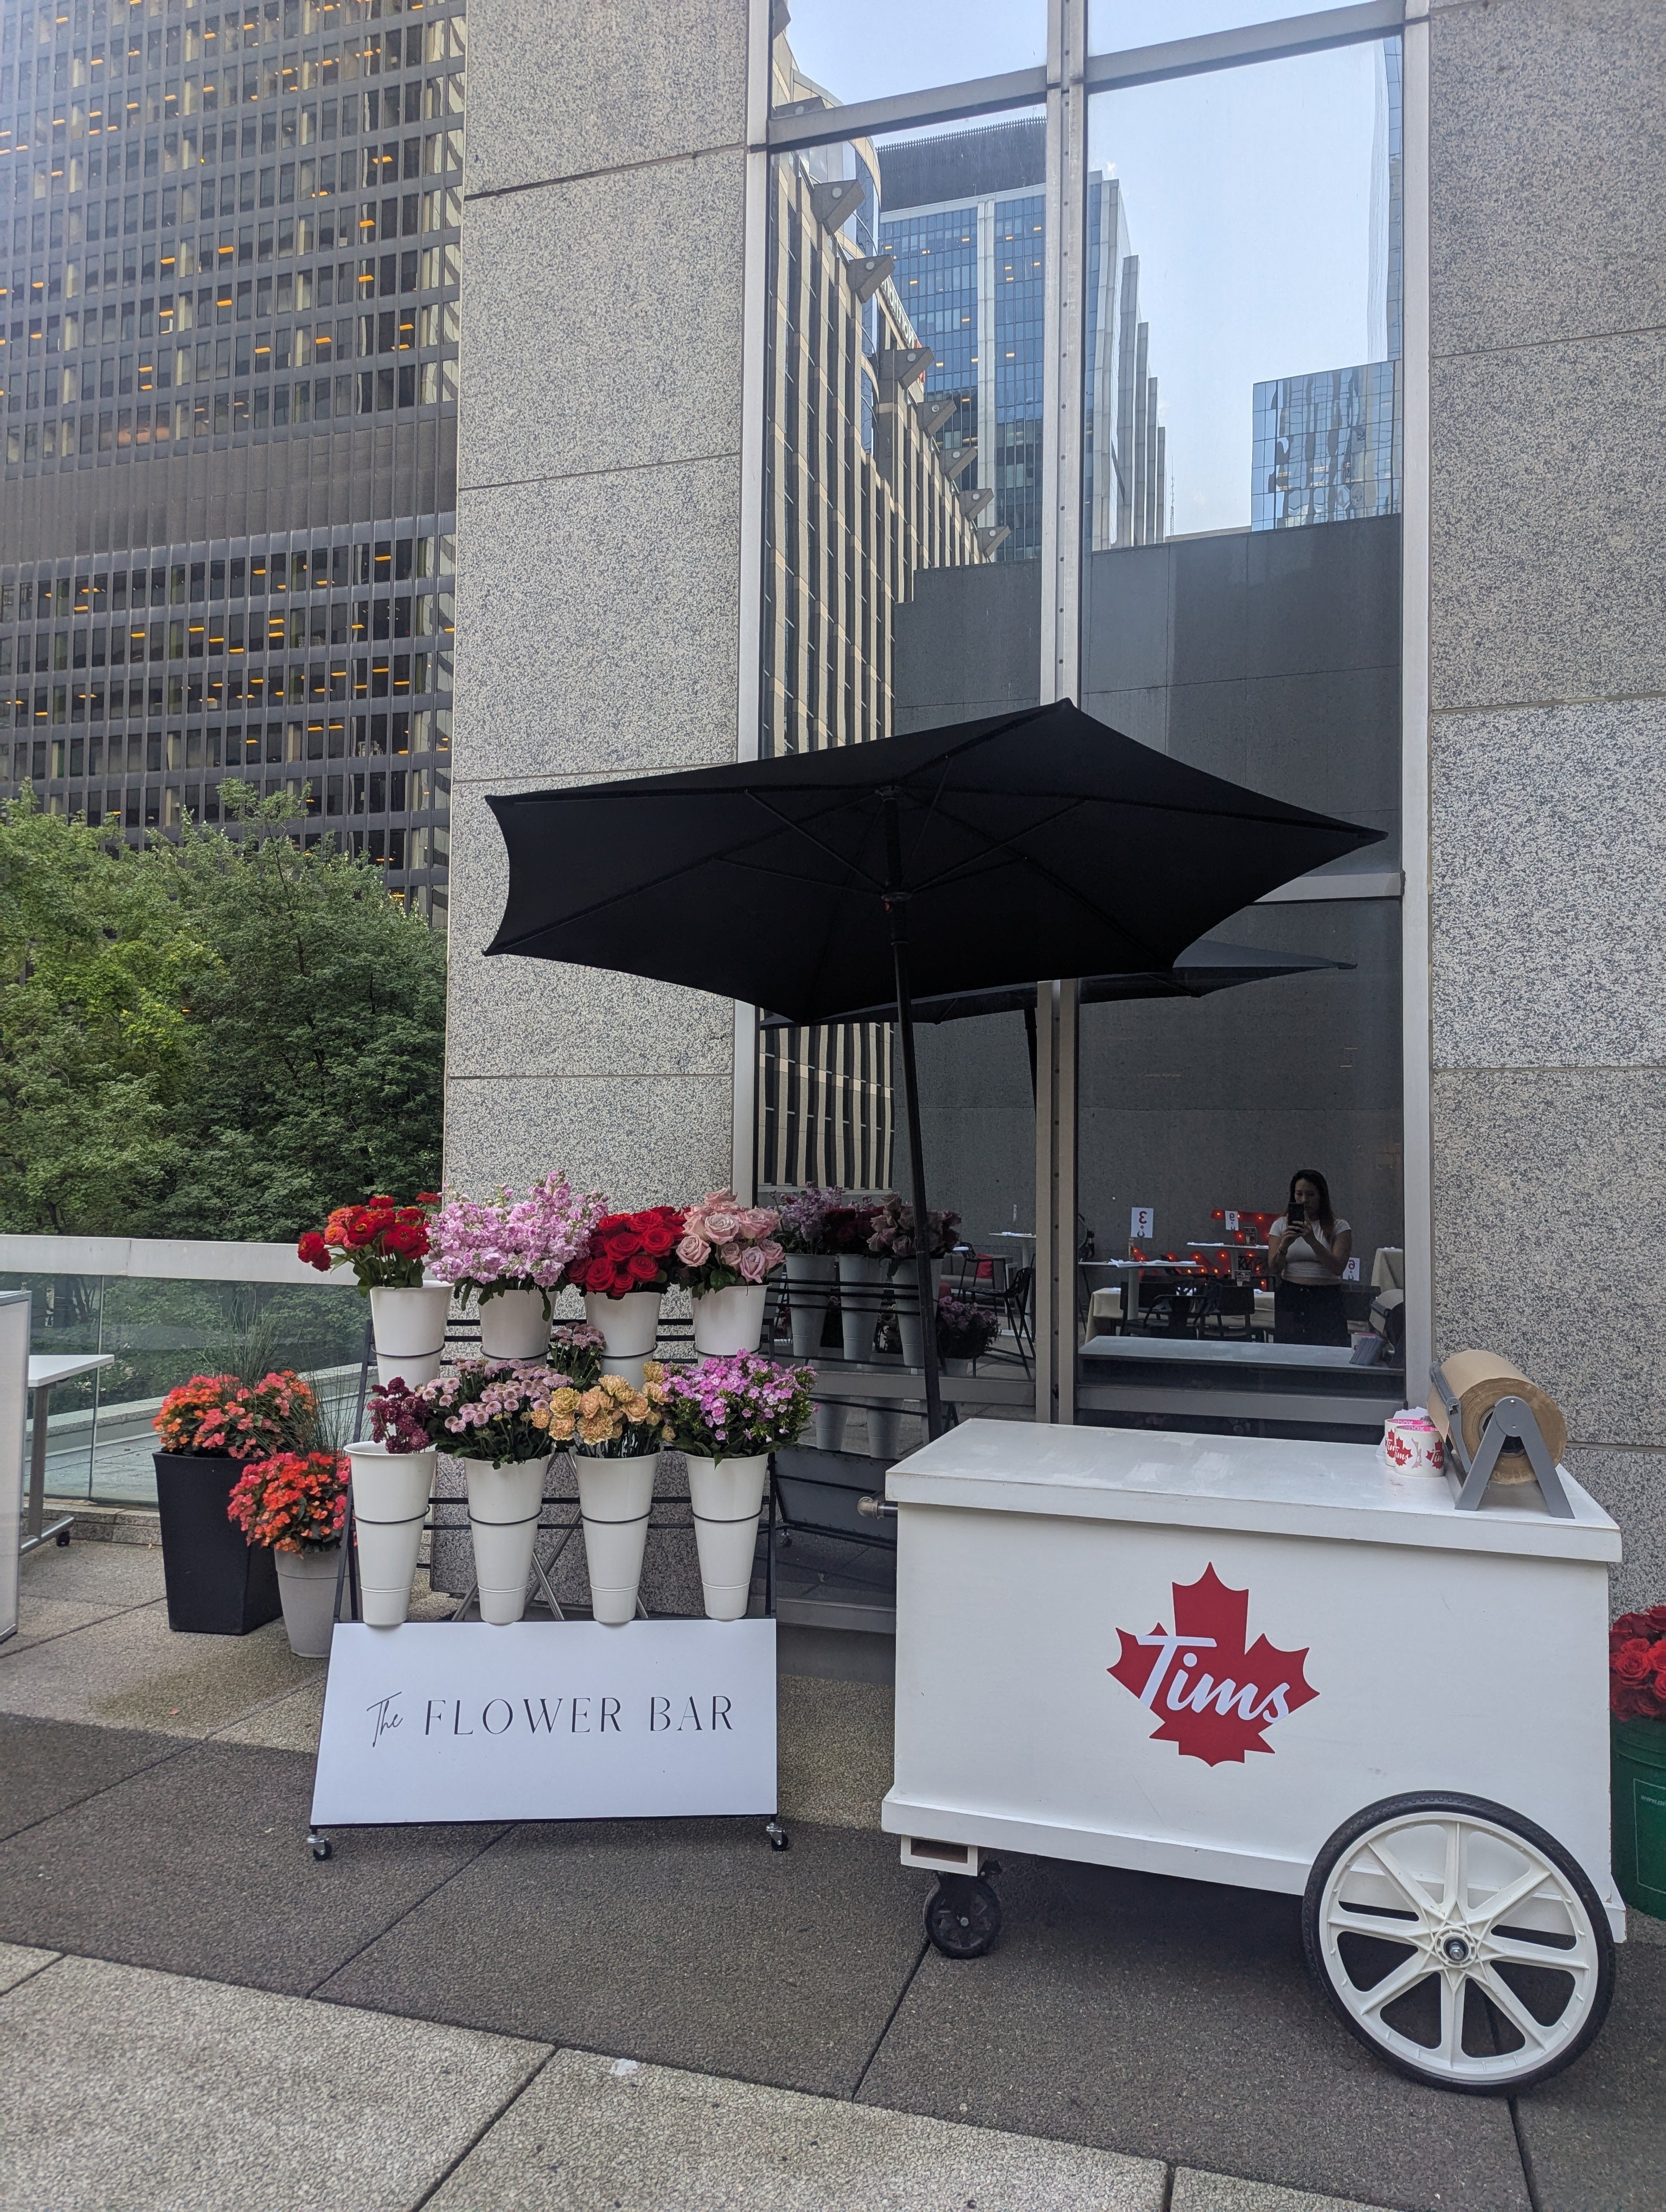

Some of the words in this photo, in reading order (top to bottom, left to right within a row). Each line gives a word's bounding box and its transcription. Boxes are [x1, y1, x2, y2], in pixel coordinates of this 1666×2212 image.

[1394, 1445, 1409, 1461] Tims
[1429, 1450, 1443, 1462] Tim
[1135, 1635, 1290, 1724] Tims
[366, 1691, 403, 1748] The
[425, 1697, 622, 1735] FLOWER
[650, 1695, 734, 1732] BAR
